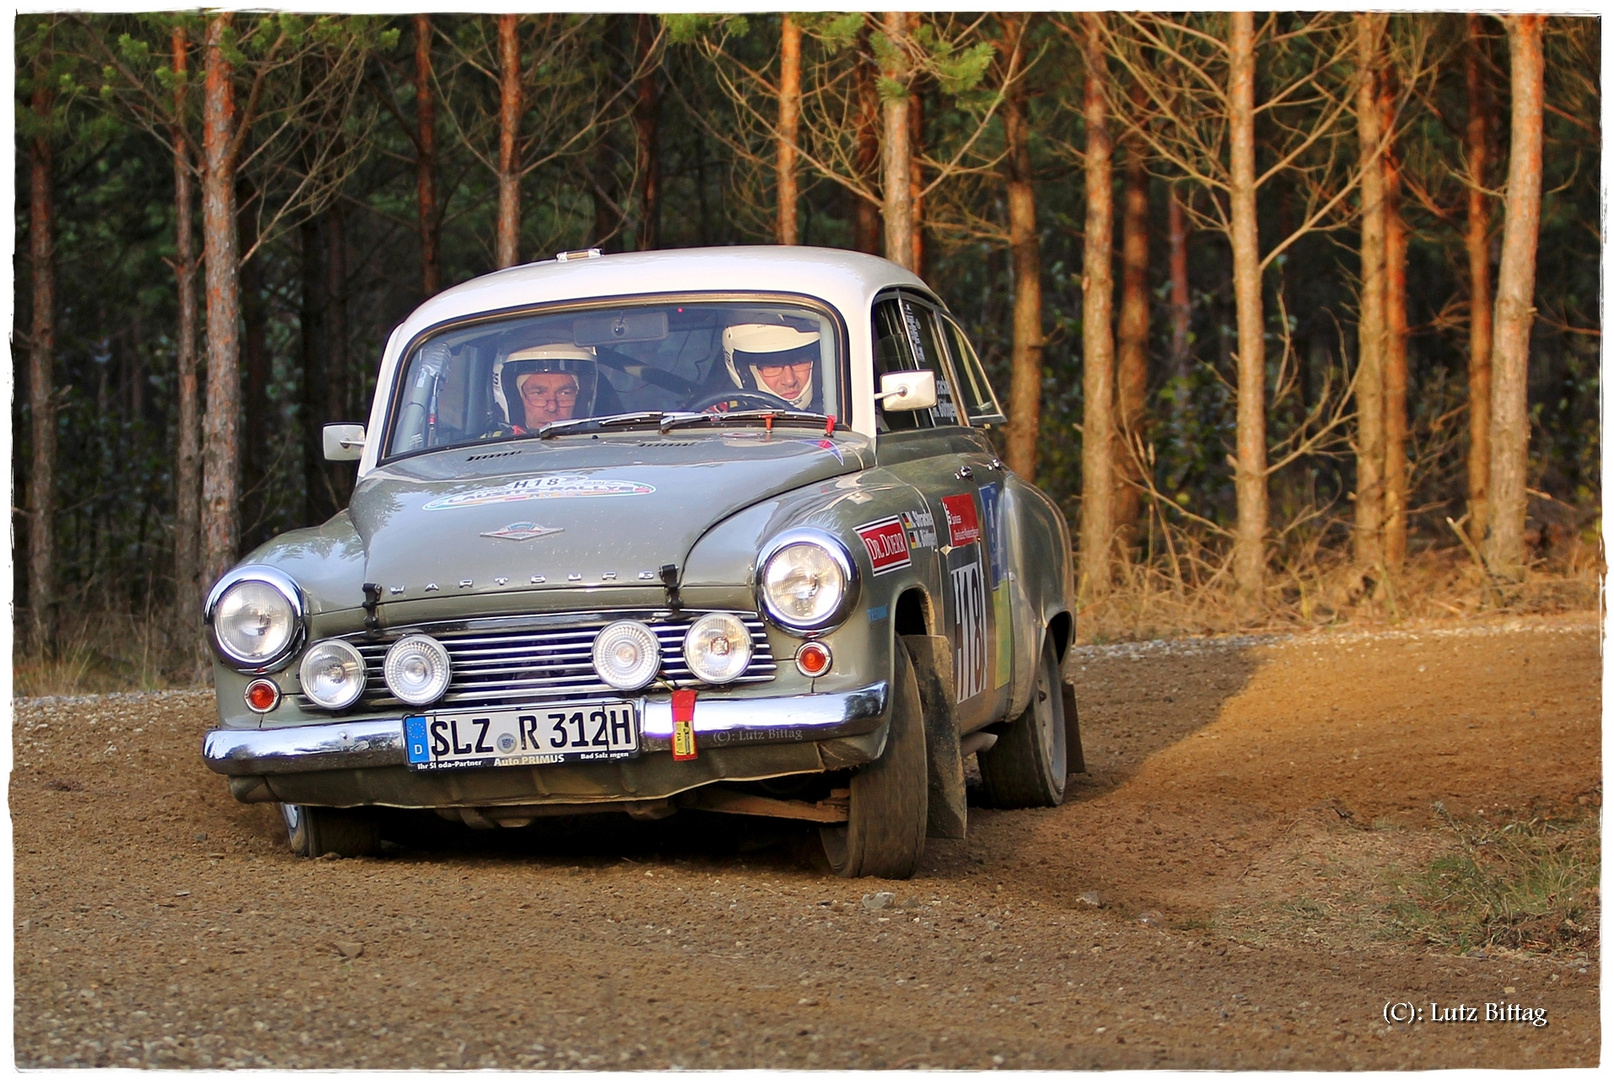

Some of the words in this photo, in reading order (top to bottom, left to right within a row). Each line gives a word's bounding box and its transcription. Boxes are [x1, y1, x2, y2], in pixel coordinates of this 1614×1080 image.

[389, 570, 655, 595] WARTBURG
[430, 718, 494, 756] SLZ
[518, 716, 541, 750] R
[547, 709, 632, 747] 312H
[414, 744, 423, 755] D
[493, 758, 520, 767] Auto
[521, 754, 565, 764] PRIMUS
